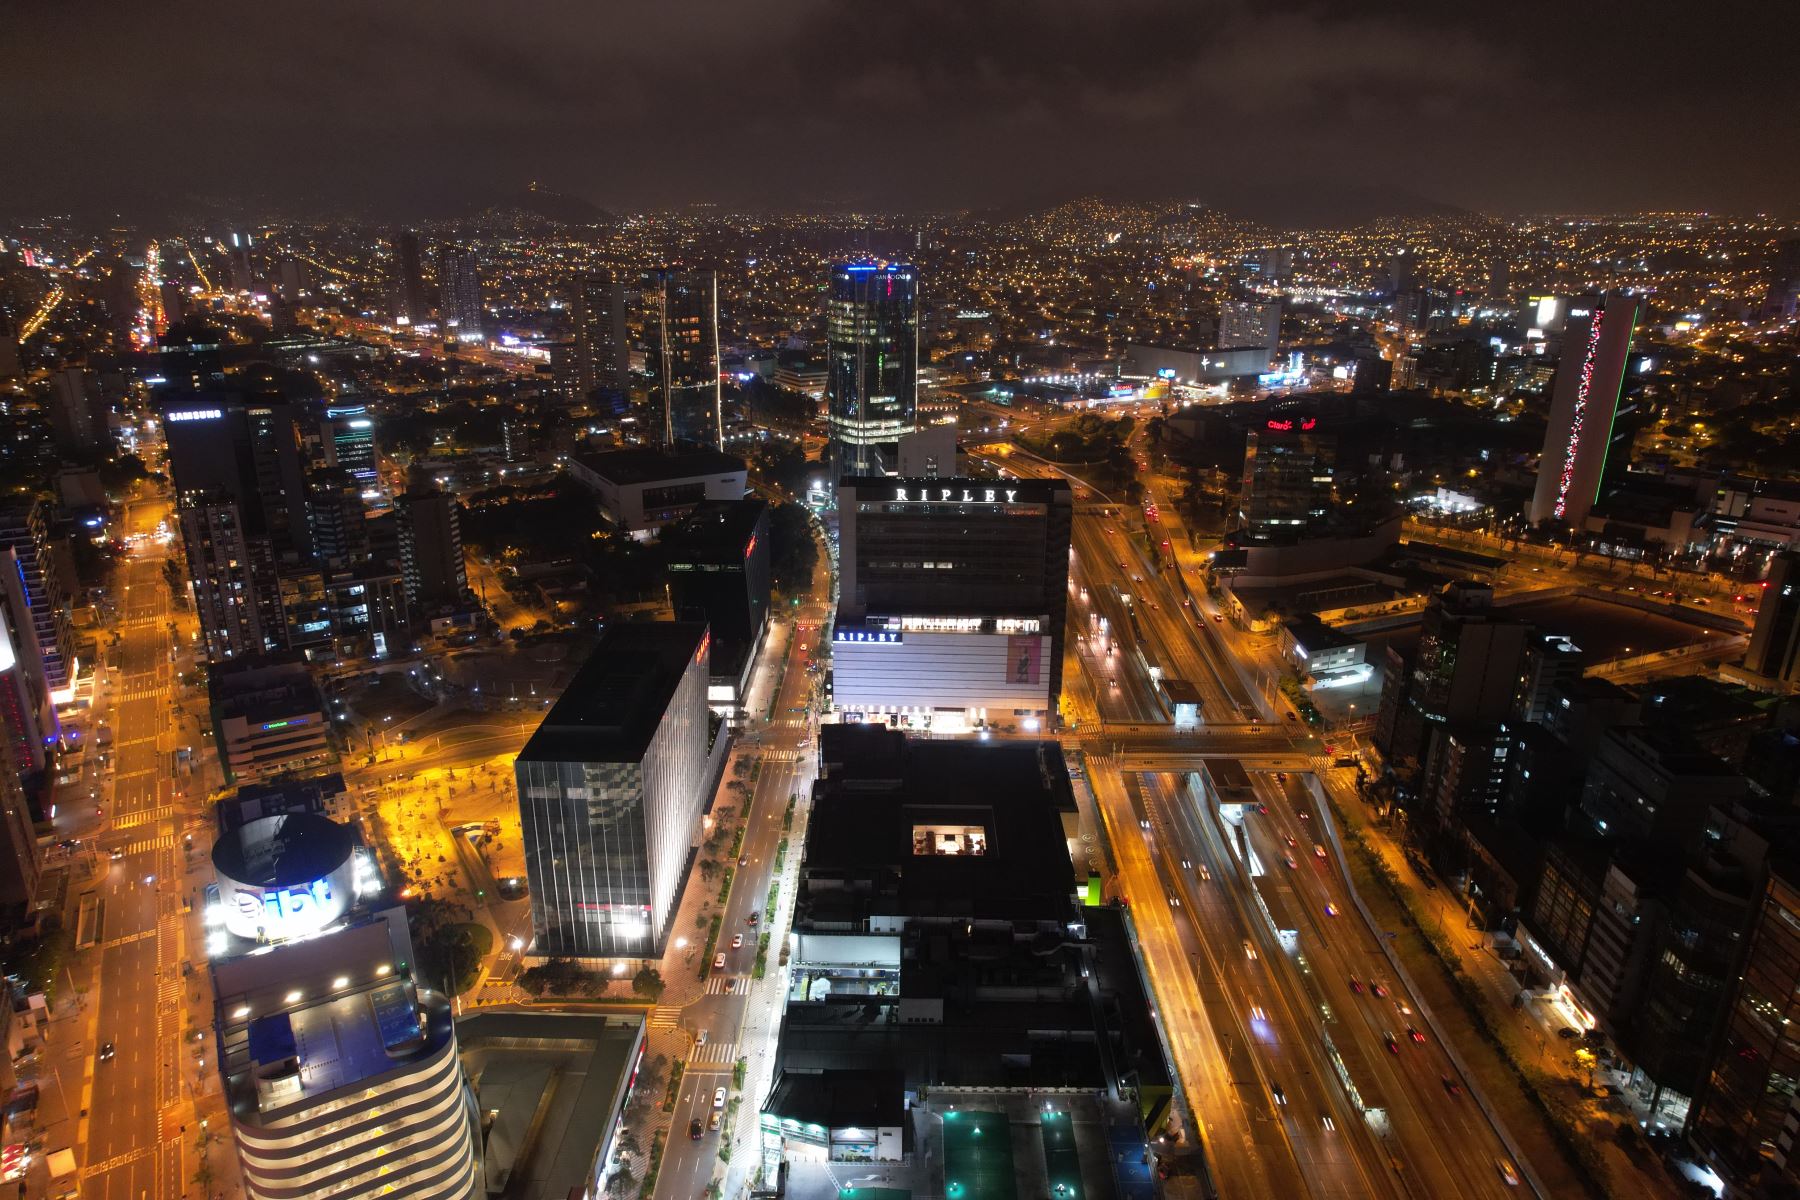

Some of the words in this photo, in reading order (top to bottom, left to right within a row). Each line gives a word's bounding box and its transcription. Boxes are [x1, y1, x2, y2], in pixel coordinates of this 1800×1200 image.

[168, 409, 222, 422] SAMSUNG
[1267, 420, 1288, 430] Claro
[896, 488, 1017, 502] RIPLEY
[838, 632, 897, 642] RIPLEY
[264, 879, 336, 924] ibt
